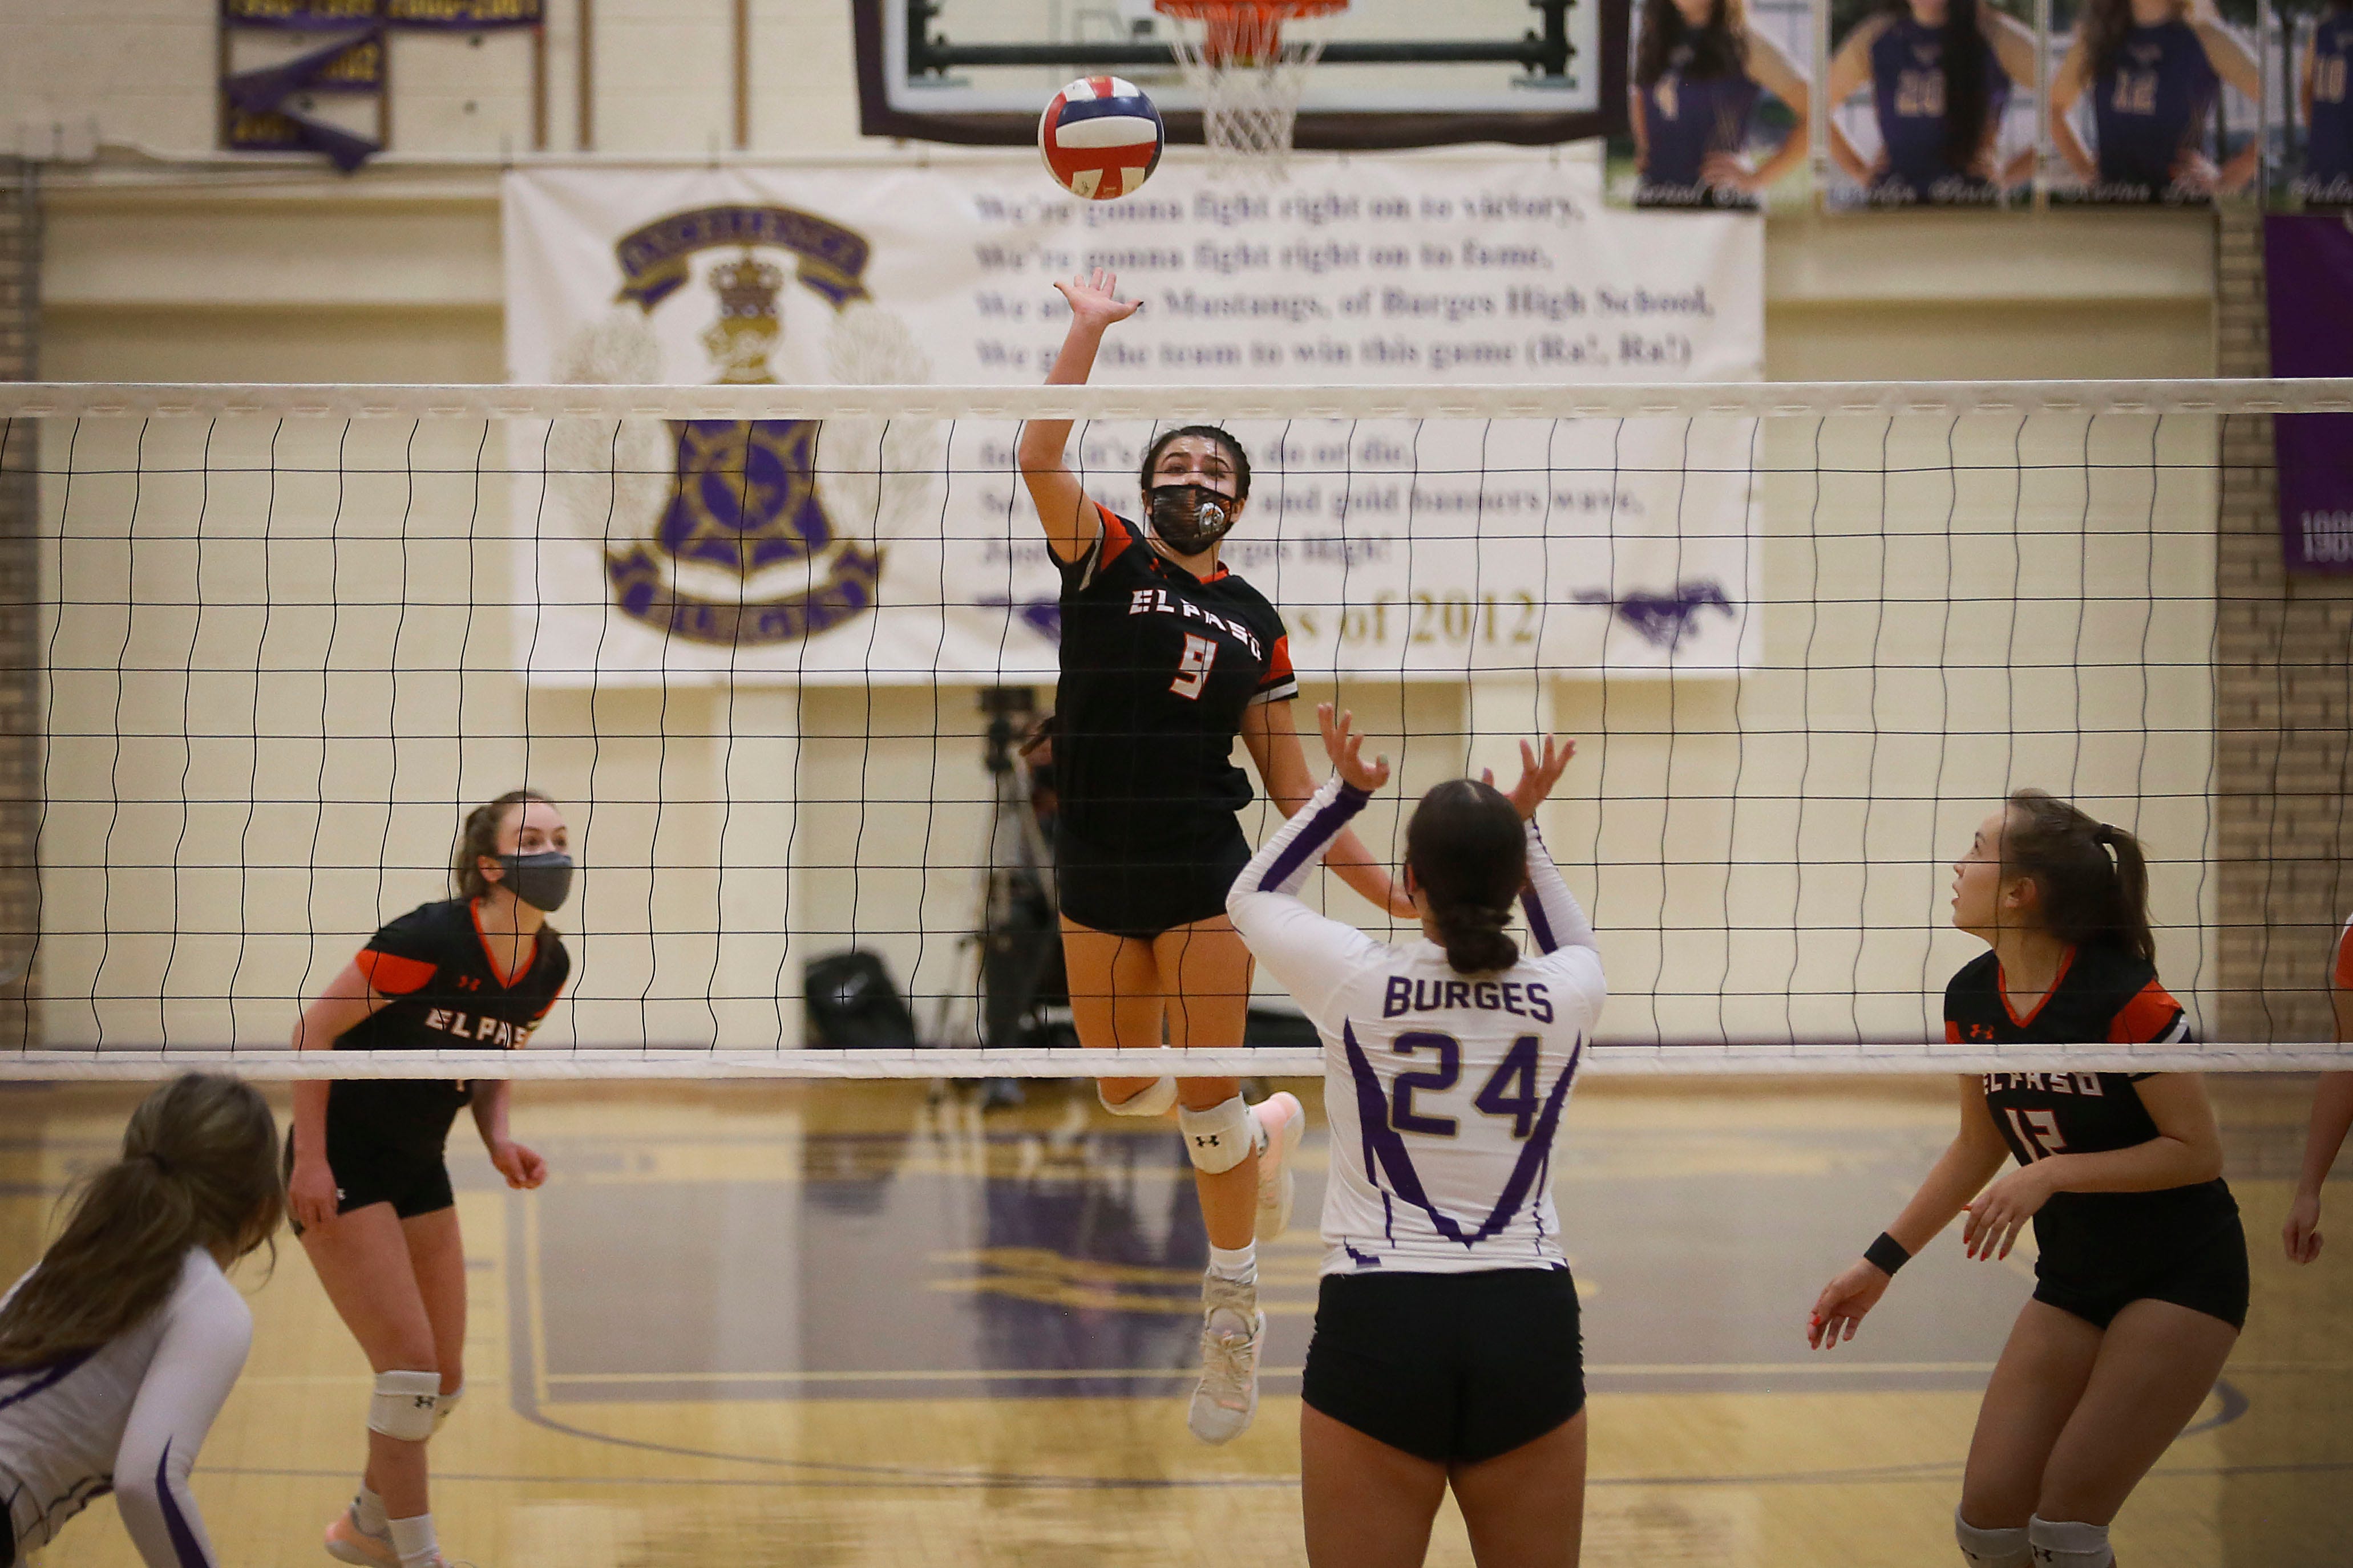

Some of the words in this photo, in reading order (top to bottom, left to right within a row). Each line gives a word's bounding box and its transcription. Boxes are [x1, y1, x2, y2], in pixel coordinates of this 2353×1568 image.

[1083, 201, 1184, 228] gonna
[1193, 190, 1270, 228] fight
[1280, 191, 1360, 228] right
[1368, 197, 1412, 220] on
[1420, 195, 1454, 220] to
[1462, 192, 1585, 228] victory,
[1194, 239, 1270, 276] fight
[1280, 240, 1360, 276] right
[1368, 246, 1411, 269] on
[1419, 243, 1454, 269] to
[1461, 237, 1553, 270] fame,
[975, 291, 1025, 319] We
[1161, 288, 1331, 324] Mustangs,
[1339, 286, 1372, 315] of
[1381, 285, 1497, 323] Burges
[1506, 285, 1587, 322] High
[1595, 285, 1715, 318] School,
[976, 340, 1026, 368] We
[1159, 343, 1242, 367] team
[1250, 342, 1283, 366] to
[1292, 341, 1352, 366] win
[1360, 337, 1421, 366] this
[1429, 342, 1517, 371] game
[1129, 589, 1176, 615] EL
[1341, 589, 1396, 647] of
[1411, 588, 1536, 647] 2012
[1169, 631, 1219, 701] 9
[1383, 976, 1554, 1024] BURGES
[424, 1008, 471, 1039] EL
[1389, 1031, 1543, 1141] 24
